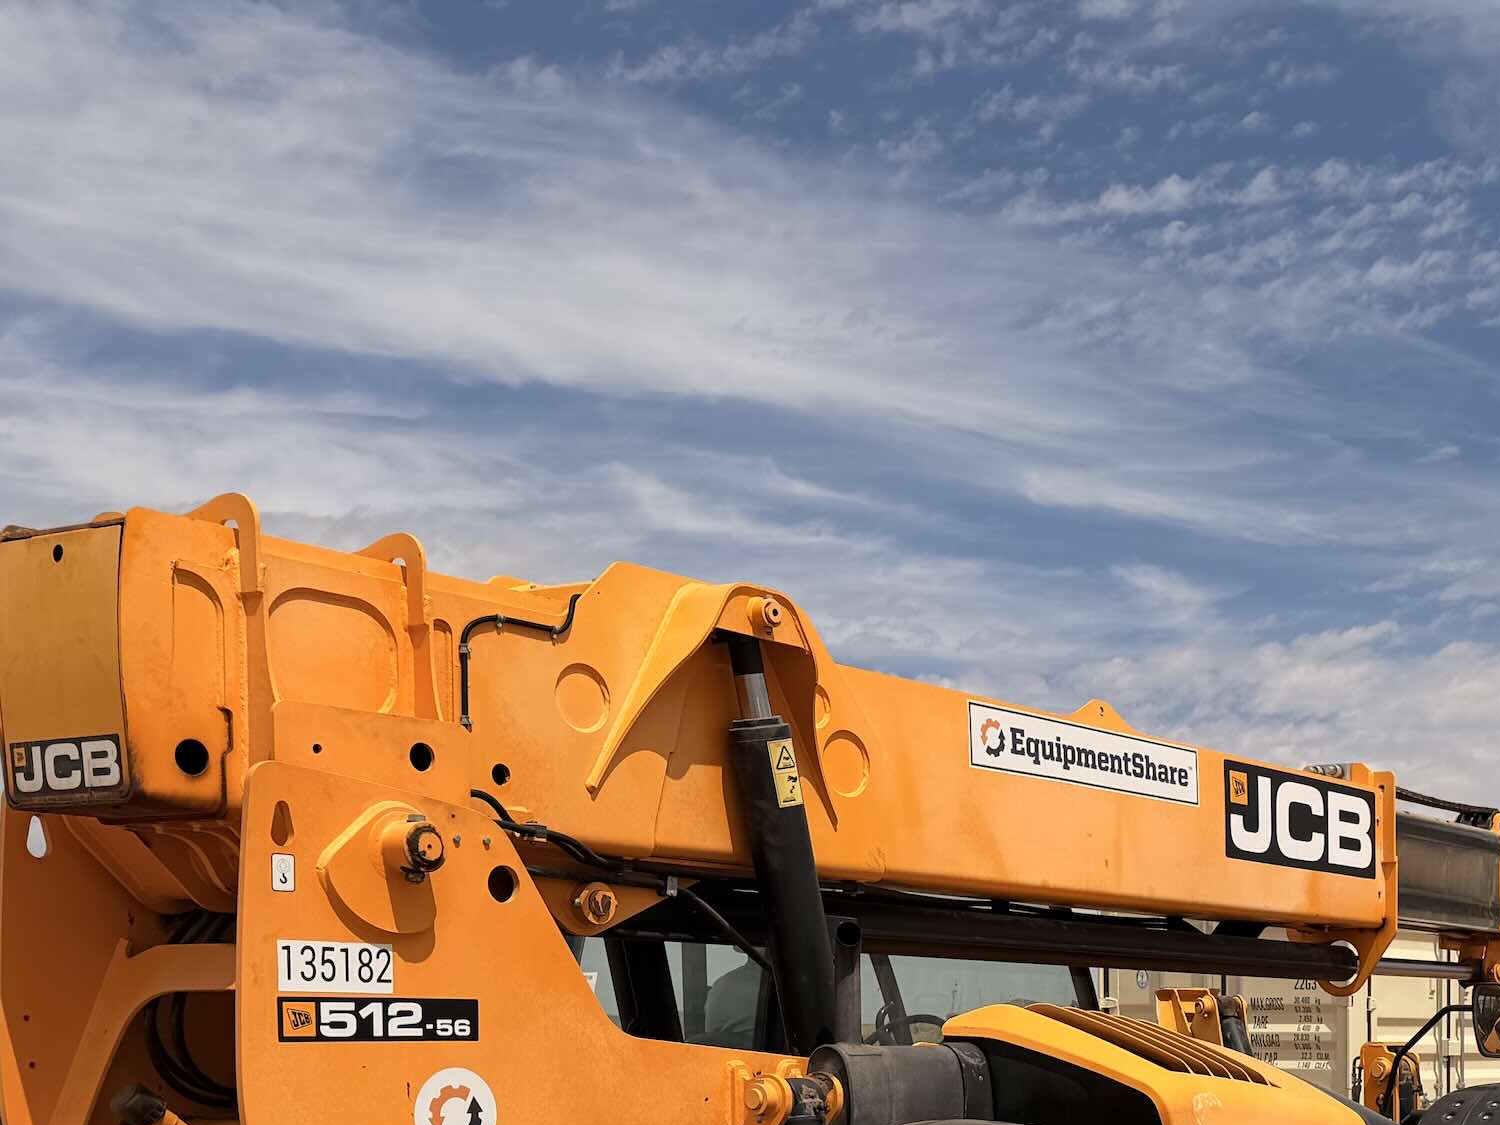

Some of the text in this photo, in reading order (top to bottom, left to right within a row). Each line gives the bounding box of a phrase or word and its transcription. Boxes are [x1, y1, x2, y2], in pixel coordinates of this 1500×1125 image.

[15, 739, 121, 793] JCB
[1010, 727, 1189, 787] EquipmentShare
[1230, 775, 1373, 870] JCB
[281, 945, 393, 984] 135182
[288, 1010, 313, 1029] JCB
[319, 1001, 471, 1038] 512-56
[1250, 1033, 1281, 1048] PAYLOAD
